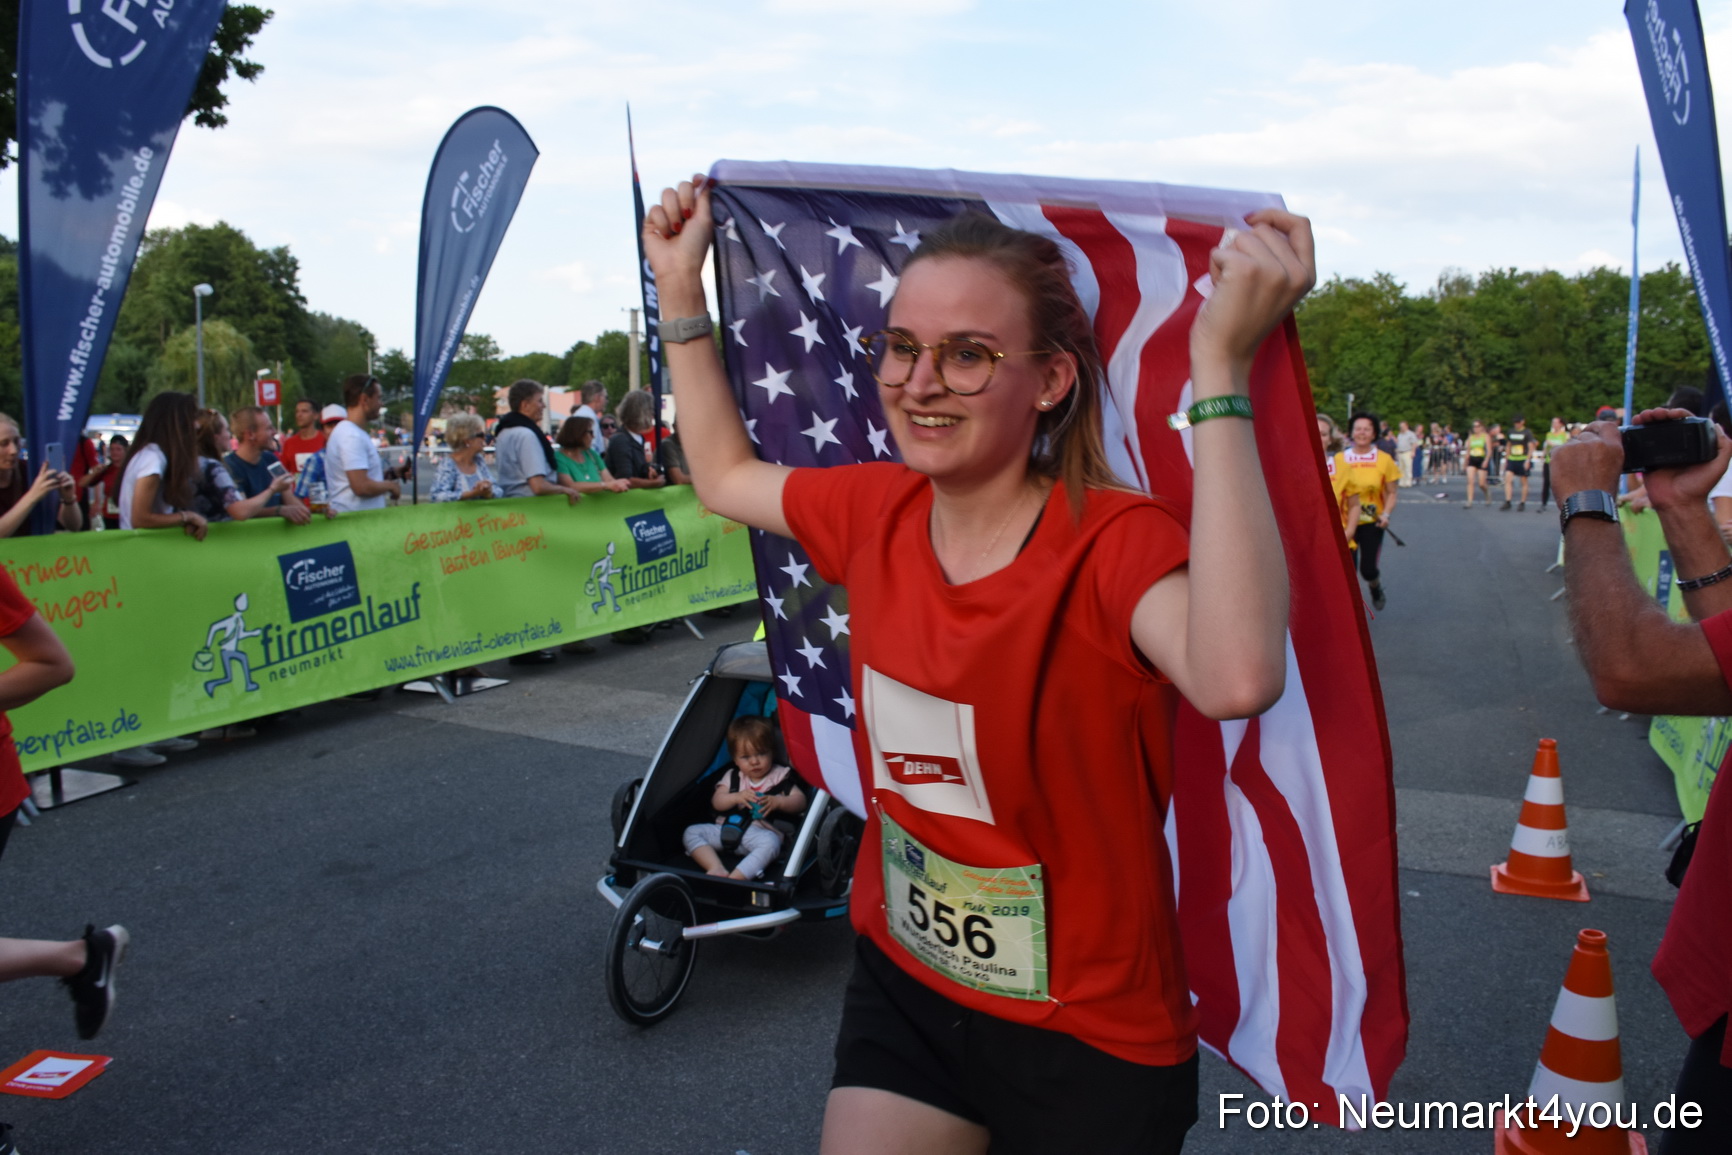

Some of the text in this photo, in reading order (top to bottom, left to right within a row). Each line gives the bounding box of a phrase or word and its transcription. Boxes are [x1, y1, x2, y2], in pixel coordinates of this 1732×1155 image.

[460, 138, 503, 220] Fischer
[56, 146, 154, 421] www.fischer-automobile.de
[403, 511, 528, 555] Gesunde Firmen
[7, 555, 94, 587] irmen
[297, 564, 346, 586] Fischer
[620, 538, 711, 596] firmenlauf
[260, 581, 421, 665] firmenlauf
[384, 617, 564, 672] www.firmenlauf-oberpfalz.de
[268, 647, 344, 683] neumarkt
[903, 761, 943, 776] DEHN
[908, 883, 997, 960] 556
[991, 905, 1030, 917] 2019
[962, 955, 1018, 977] Paulina
